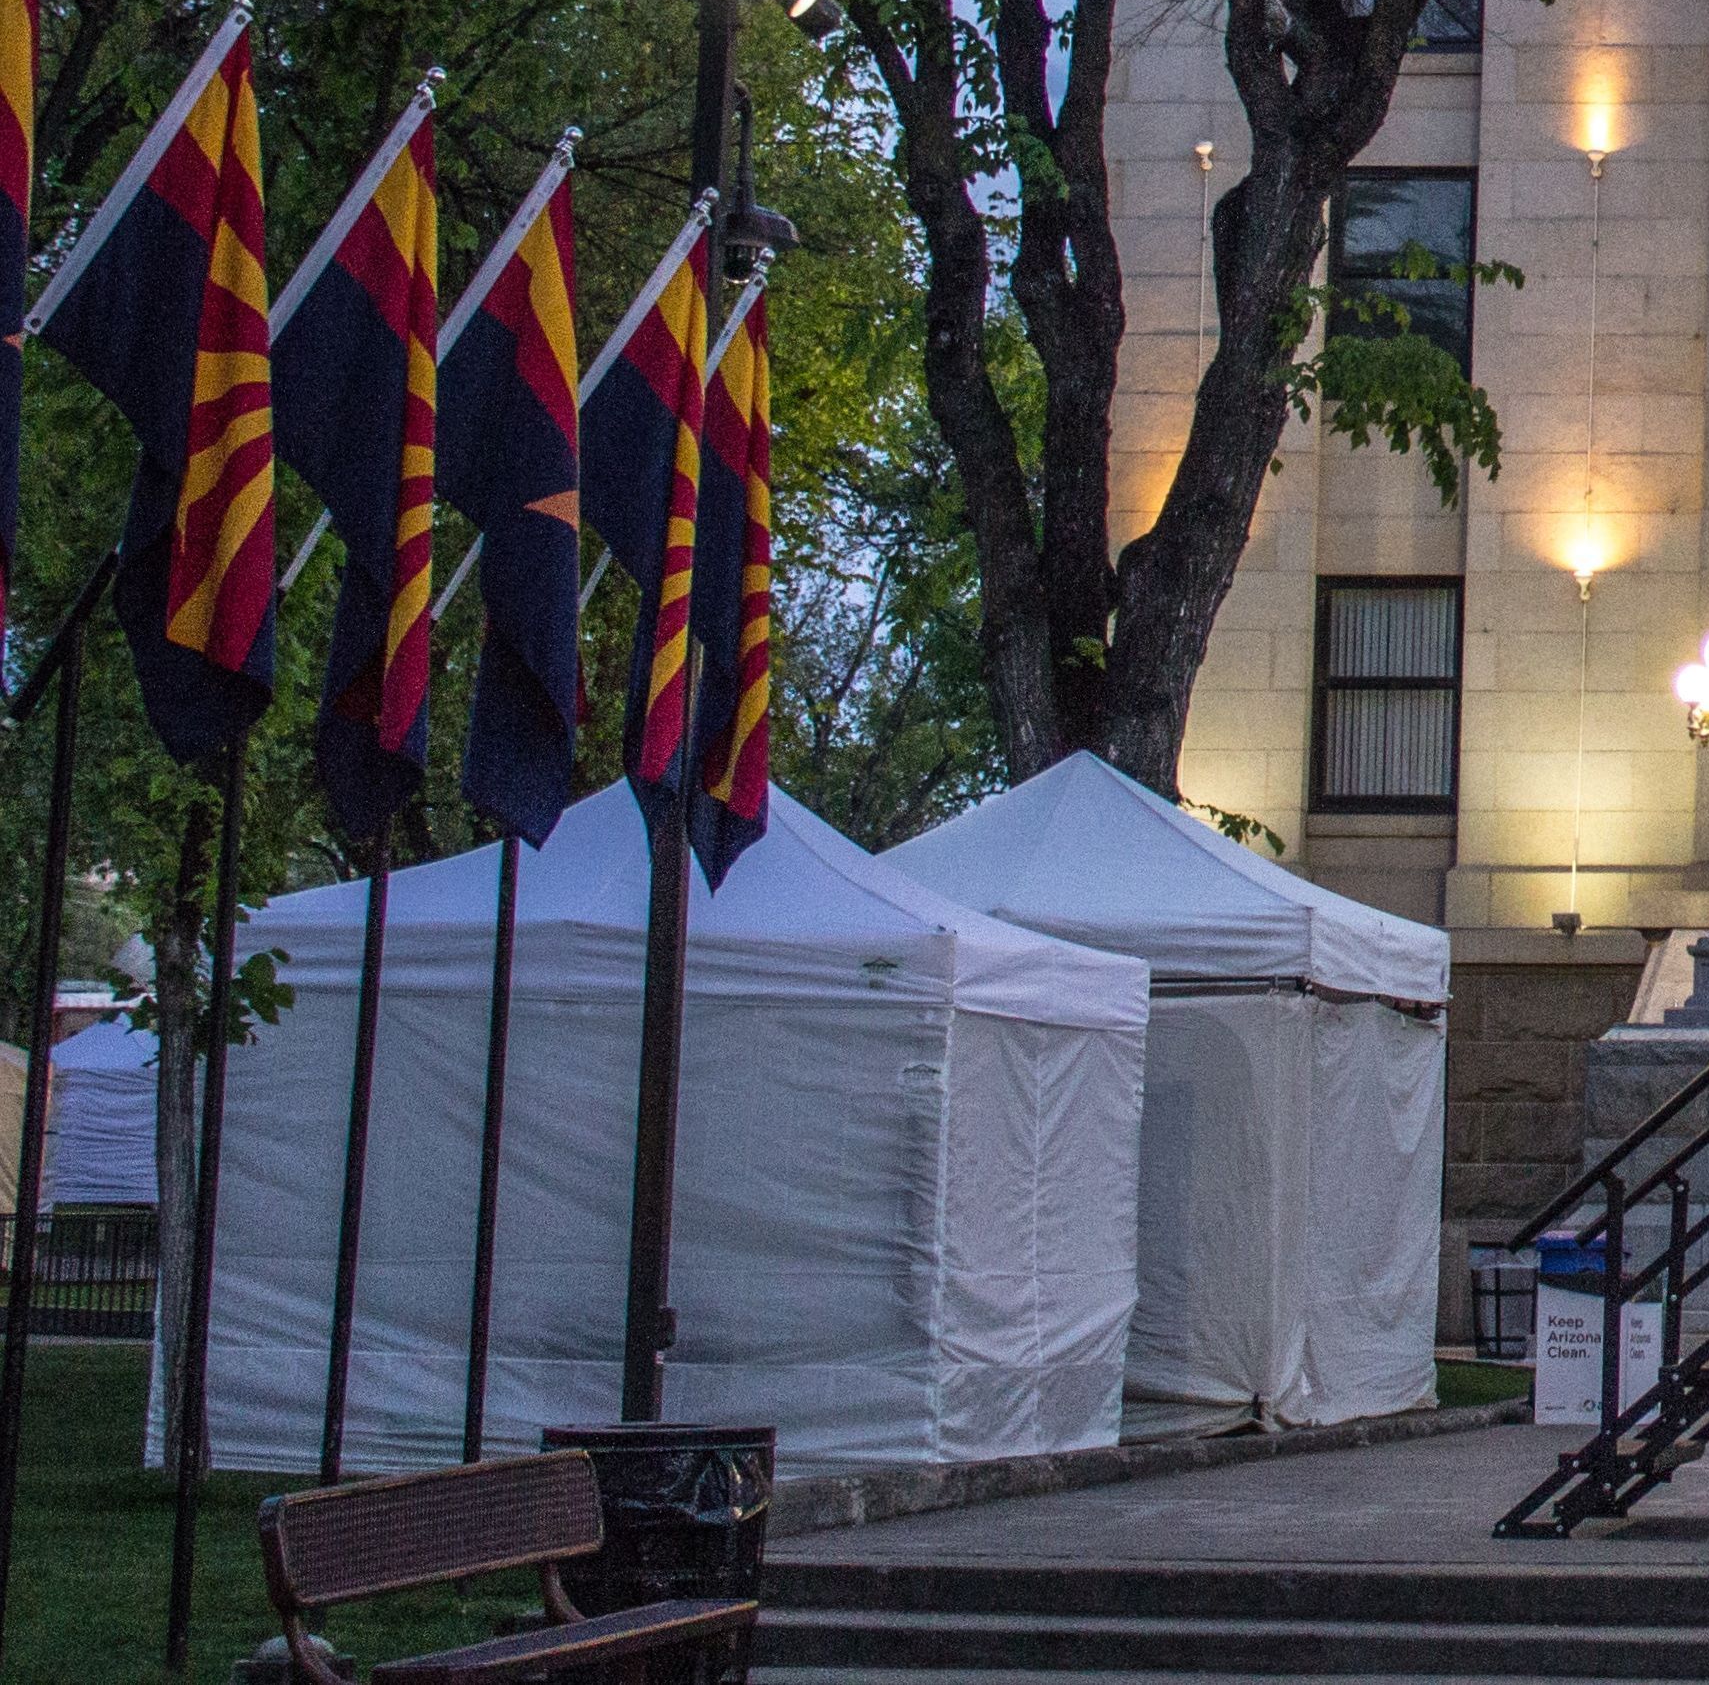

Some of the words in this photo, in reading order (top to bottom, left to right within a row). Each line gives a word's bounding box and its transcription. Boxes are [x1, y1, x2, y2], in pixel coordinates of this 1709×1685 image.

[1548, 1315, 1584, 1329] Keep
[1547, 1330, 1602, 1343] Arizona
[1547, 1346, 1590, 1358] Clean.
